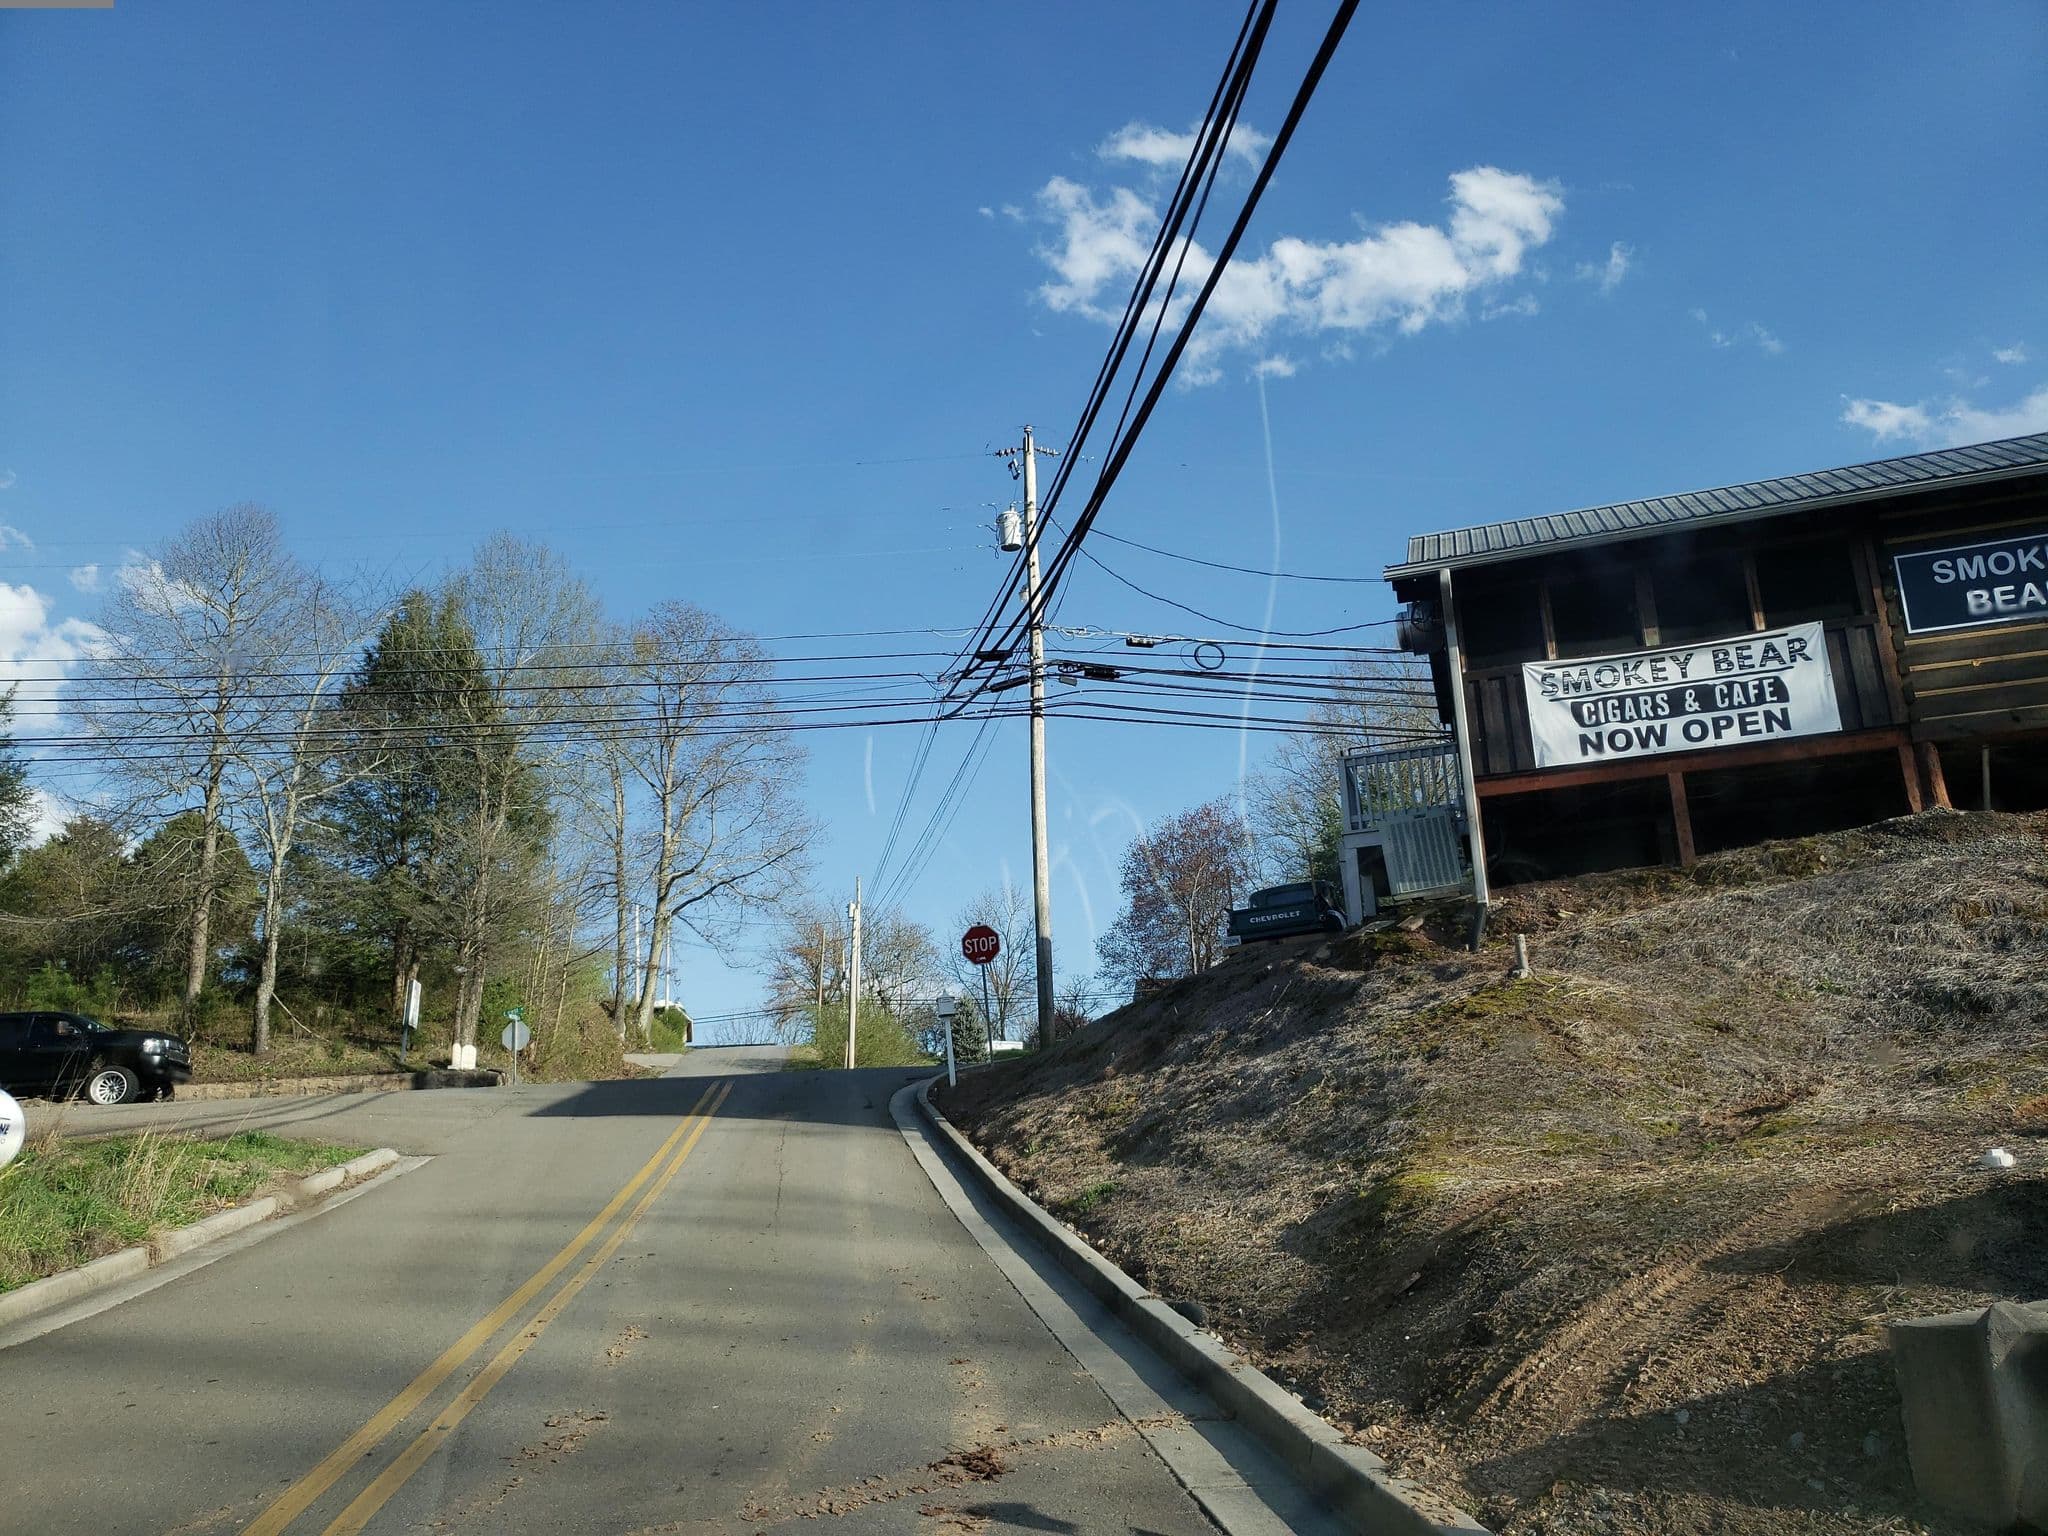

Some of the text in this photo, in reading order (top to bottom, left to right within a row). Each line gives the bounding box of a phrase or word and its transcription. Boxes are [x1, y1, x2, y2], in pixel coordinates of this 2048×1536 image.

[1932, 545, 2048, 584] SMOK
[1966, 582, 2048, 616] BEA
[1540, 636, 1814, 697] SMOKEY BEAR
[1582, 678, 1779, 726] CIGARS & CAFE
[1579, 706, 1793, 756] NOW OPEN
[1249, 910, 1301, 924] CHEVROLET
[964, 936, 997, 954] STOP
